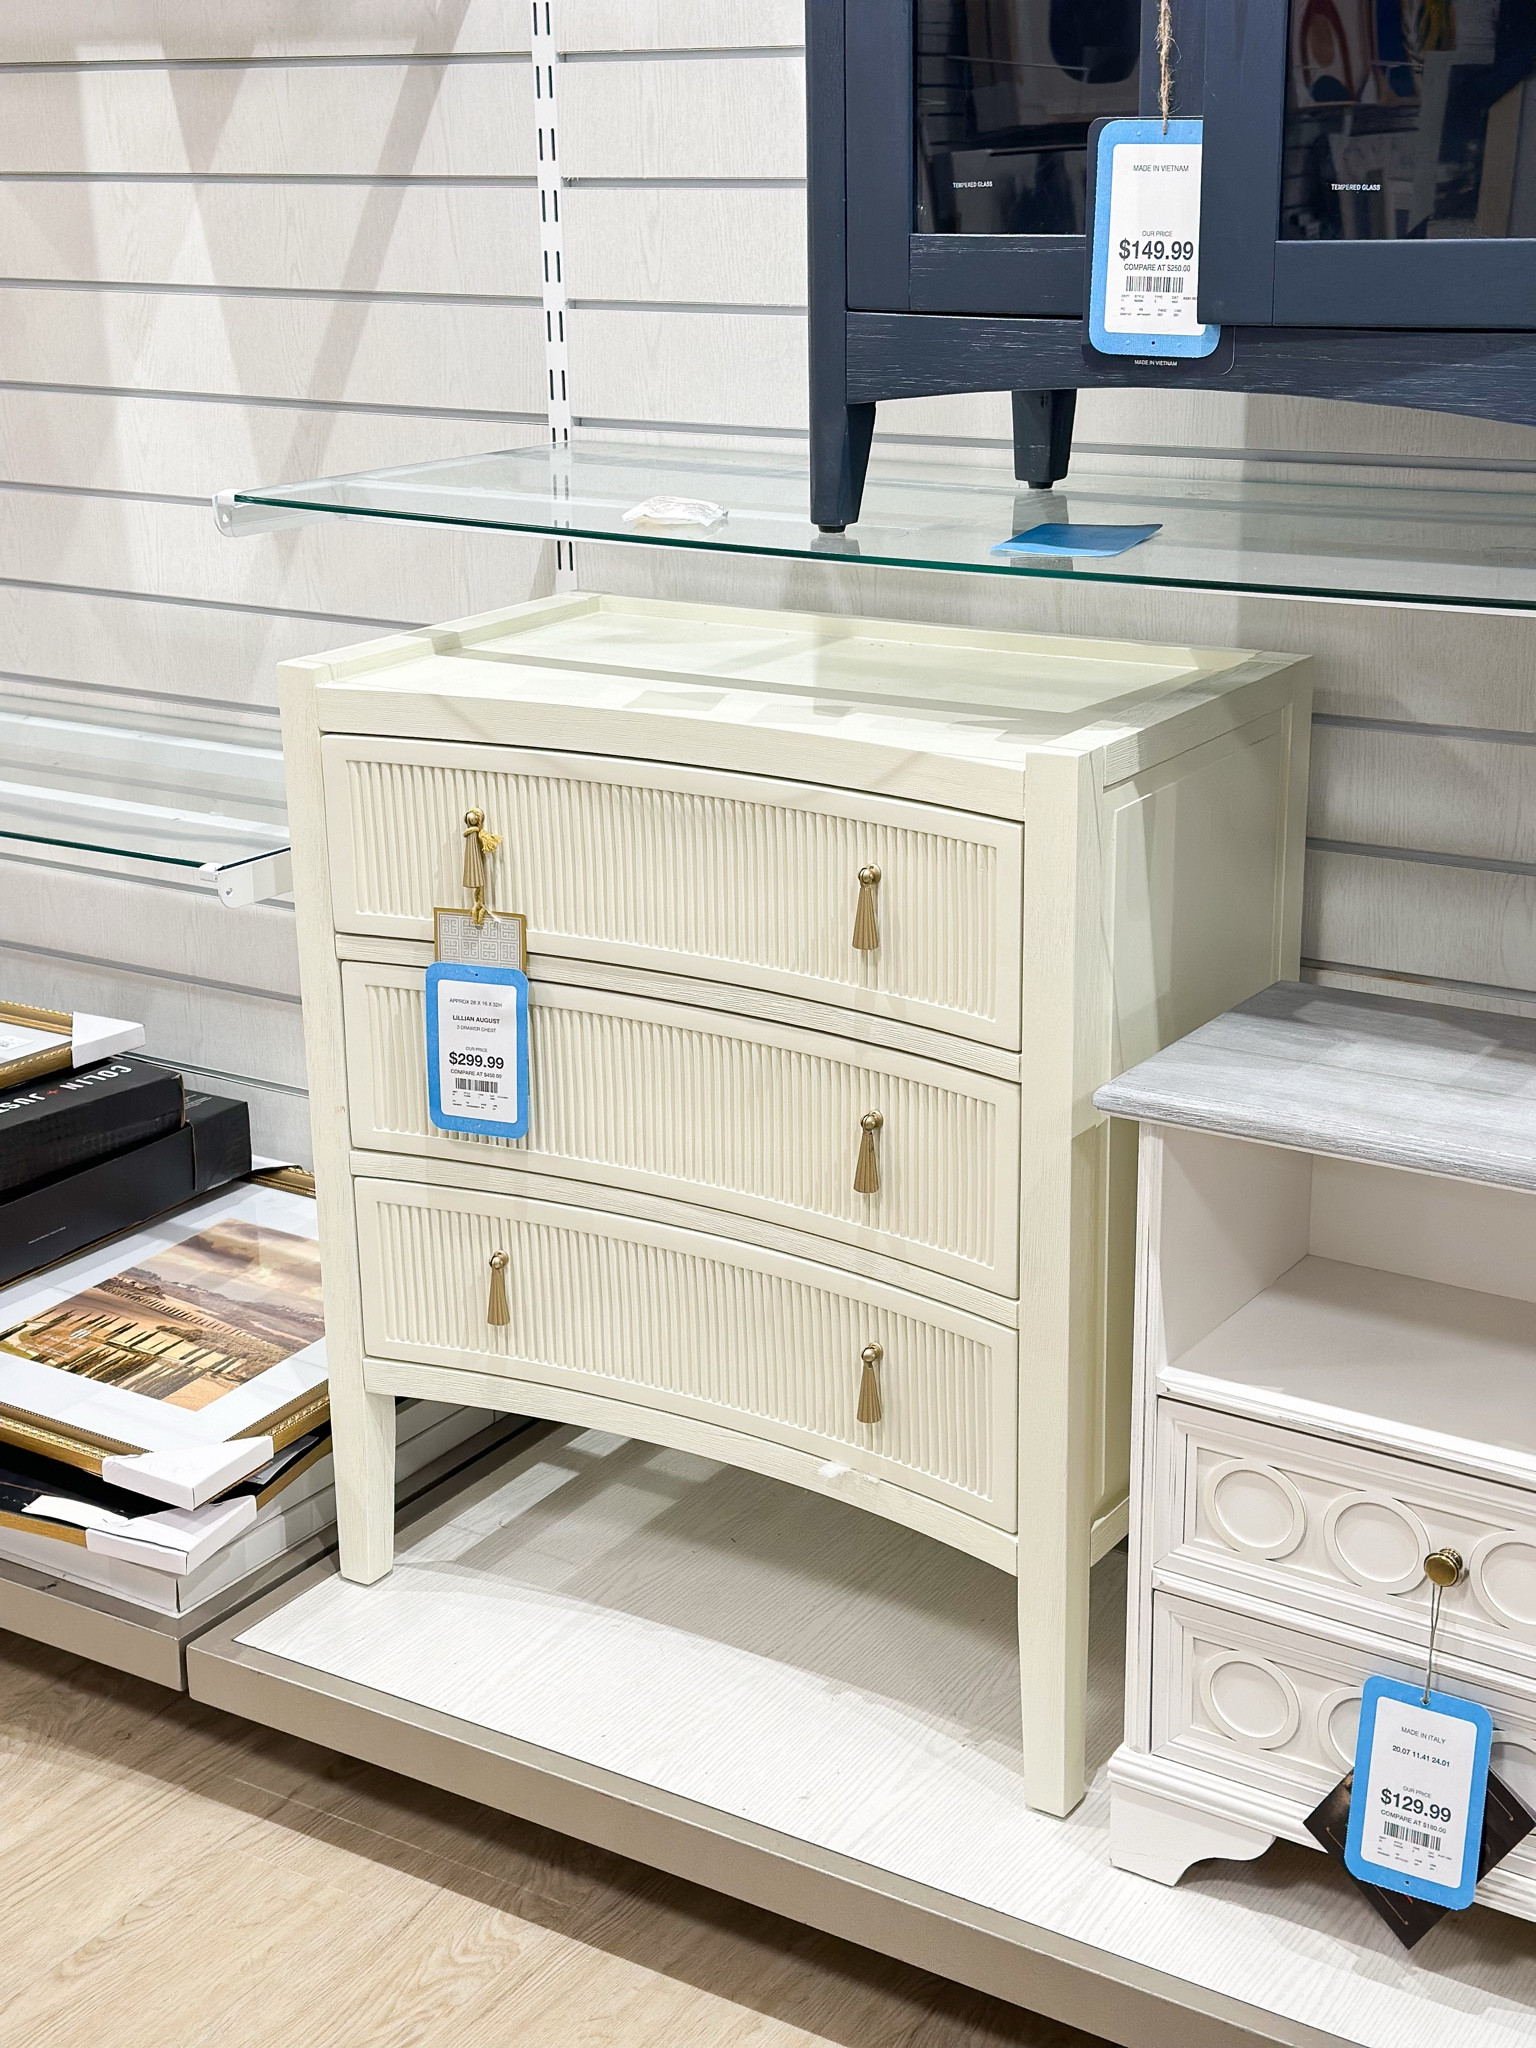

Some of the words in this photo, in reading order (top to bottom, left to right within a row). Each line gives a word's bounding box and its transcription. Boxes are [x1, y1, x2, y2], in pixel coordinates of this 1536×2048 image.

[1133, 164, 1152, 172] MADE
[977, 180, 993, 188] GLASS
[1362, 183, 1381, 191] GLASS
[1119, 237, 1194, 261] $149.99
[1124, 263, 1156, 271] COMPARE
[1167, 264, 1191, 272] $250.00
[452, 1014, 475, 1022] LILLIAN
[476, 1016, 500, 1024] AUGUST
[449, 1051, 504, 1069] $299.99
[60, 1065, 132, 1091] COLIN
[1401, 1726, 1419, 1737] MADE
[1420, 1732, 1427, 1740] IN
[1428, 1735, 1446, 1744] ITALY
[1392, 1744, 1411, 1755] 20.07
[1412, 1751, 1430, 1762] 11.41
[1431, 1756, 1450, 1767] 24.01
[1402, 1785, 1415, 1794] OUR
[1415, 1790, 1431, 1798] PRICE
[1381, 1787, 1451, 1822] $129.99
[1380, 1809, 1412, 1824] COMPARE
